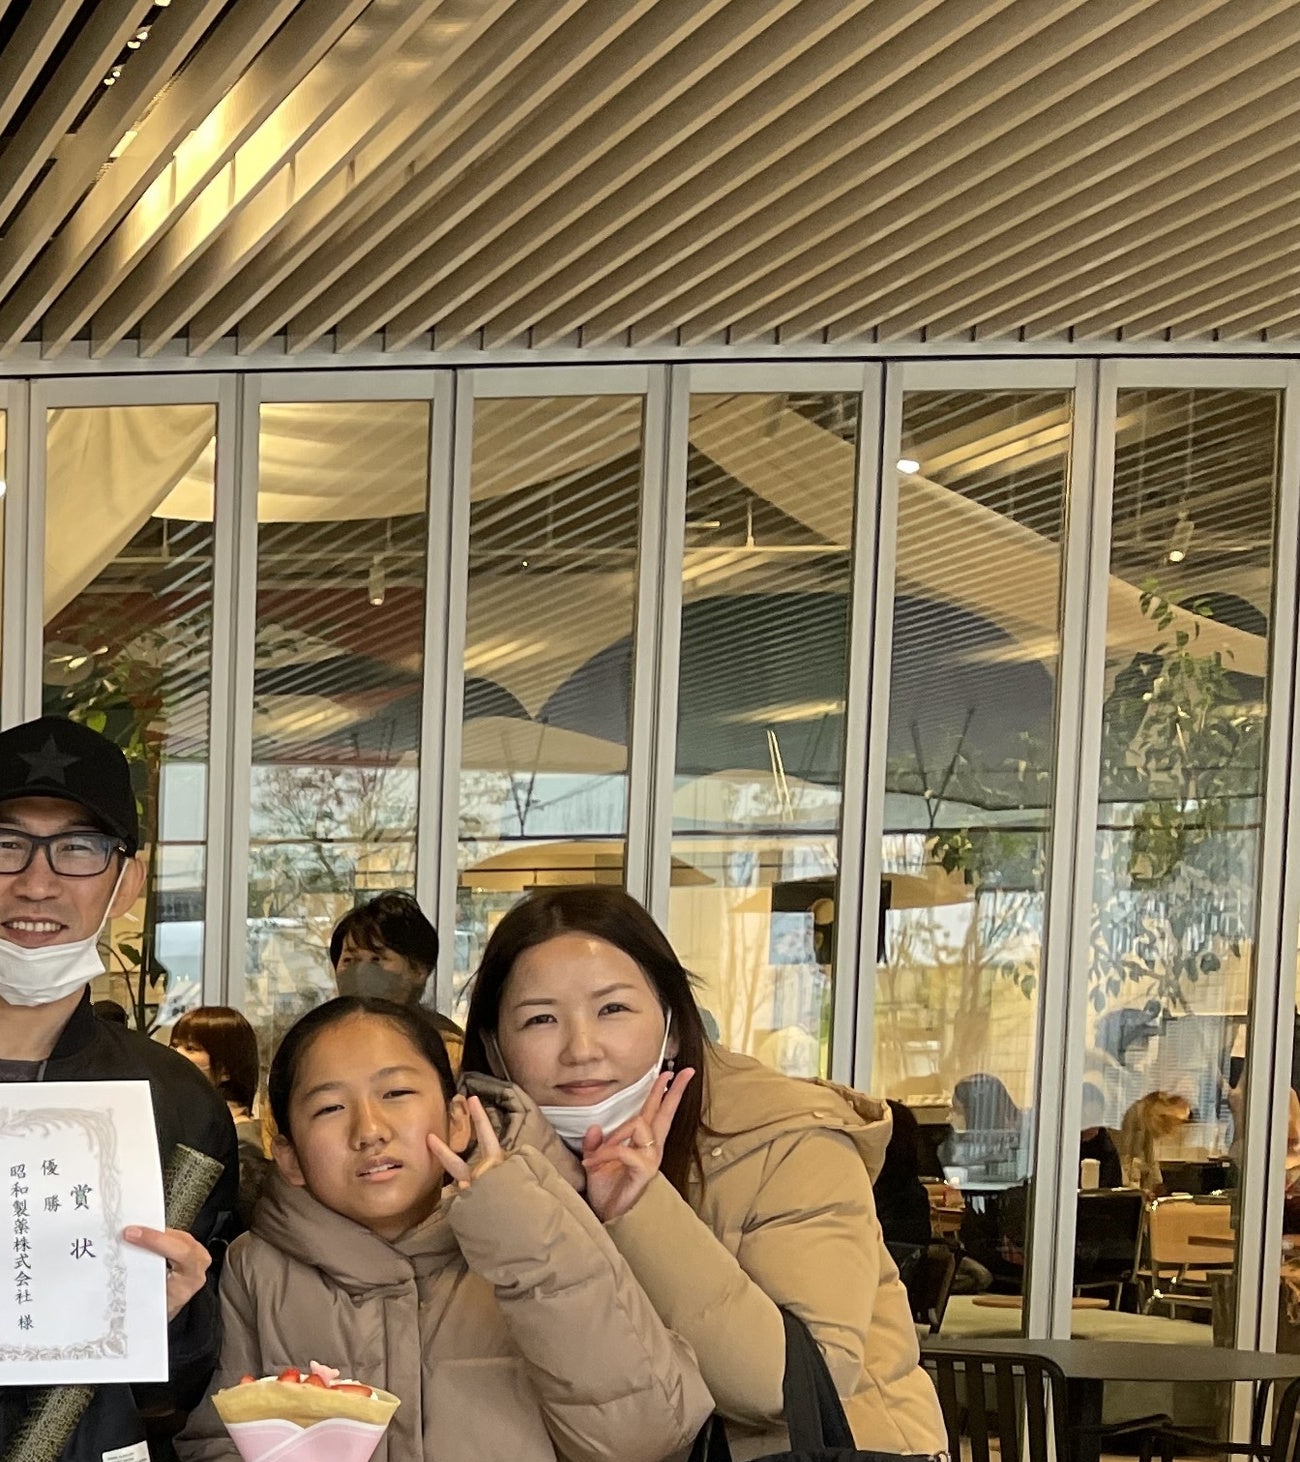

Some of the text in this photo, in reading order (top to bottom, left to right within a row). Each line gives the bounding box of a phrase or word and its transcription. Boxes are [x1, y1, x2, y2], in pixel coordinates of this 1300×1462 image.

[41, 1158, 62, 1212] 優勝
[69, 1184, 96, 1260] 賞状
[10, 1163, 34, 1331] 昭和製薬株式会社 様
